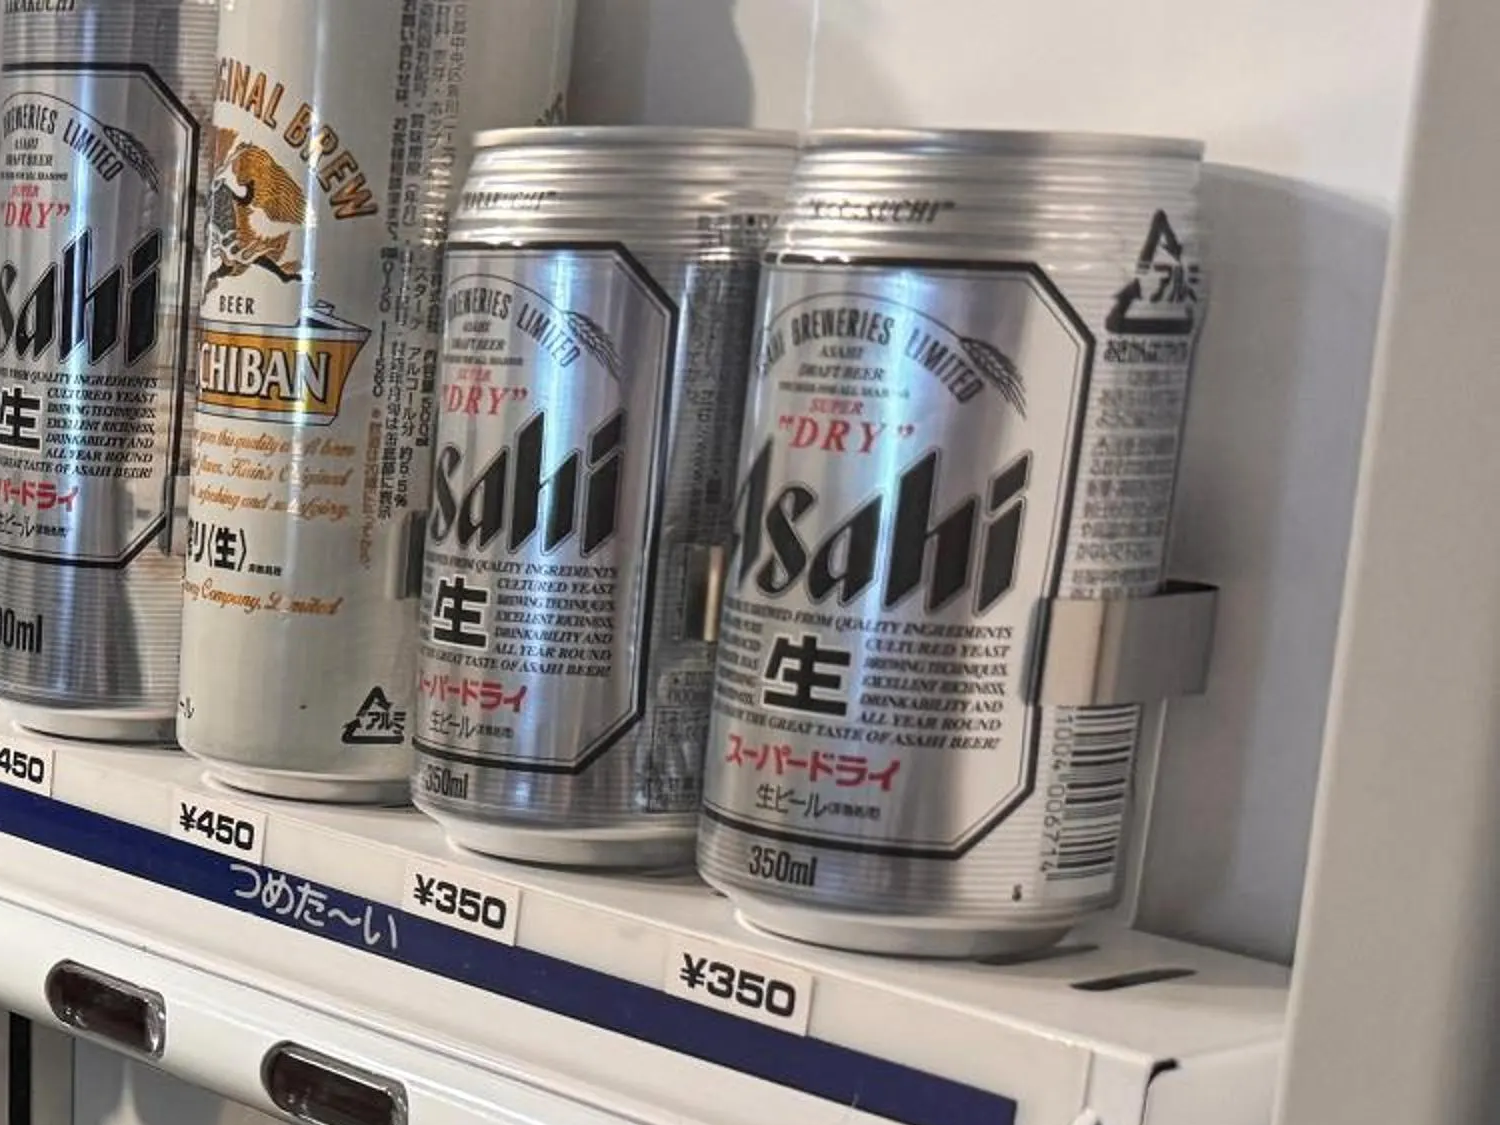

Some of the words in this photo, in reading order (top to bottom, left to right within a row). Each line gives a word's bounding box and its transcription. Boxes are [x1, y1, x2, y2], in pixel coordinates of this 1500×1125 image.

[63, 118, 125, 182] LIMITED
[284, 103, 379, 221] BREW
[218, 295, 255, 315] BEER
[516, 302, 581, 369] LIMITED
[791, 308, 896, 347] BREWERIES
[905, 328, 986, 404] LIMITED
[778, 414, 916, 454] "DRY"
[430, 406, 628, 557] sahi
[433, 576, 489, 648] 生
[864, 638, 955, 656] CULTURED
[958, 642, 1012, 659] YEAST
[763, 635, 851, 717] 生
[363, 710, 407, 736] アルミ
[858, 710, 889, 725] ALL
[891, 711, 938, 730] YEAR
[939, 714, 1003, 732] ROUND
[971, 698, 1005, 714] AND
[725, 733, 901, 793] スーパードライ
[895, 729, 949, 749] ASAHI
[423, 763, 470, 801] 350ml
[179, 801, 256, 852] ¥450
[749, 845, 819, 888] 350ml
[413, 872, 508, 930] ¥350
[679, 952, 798, 1018] ¥350
